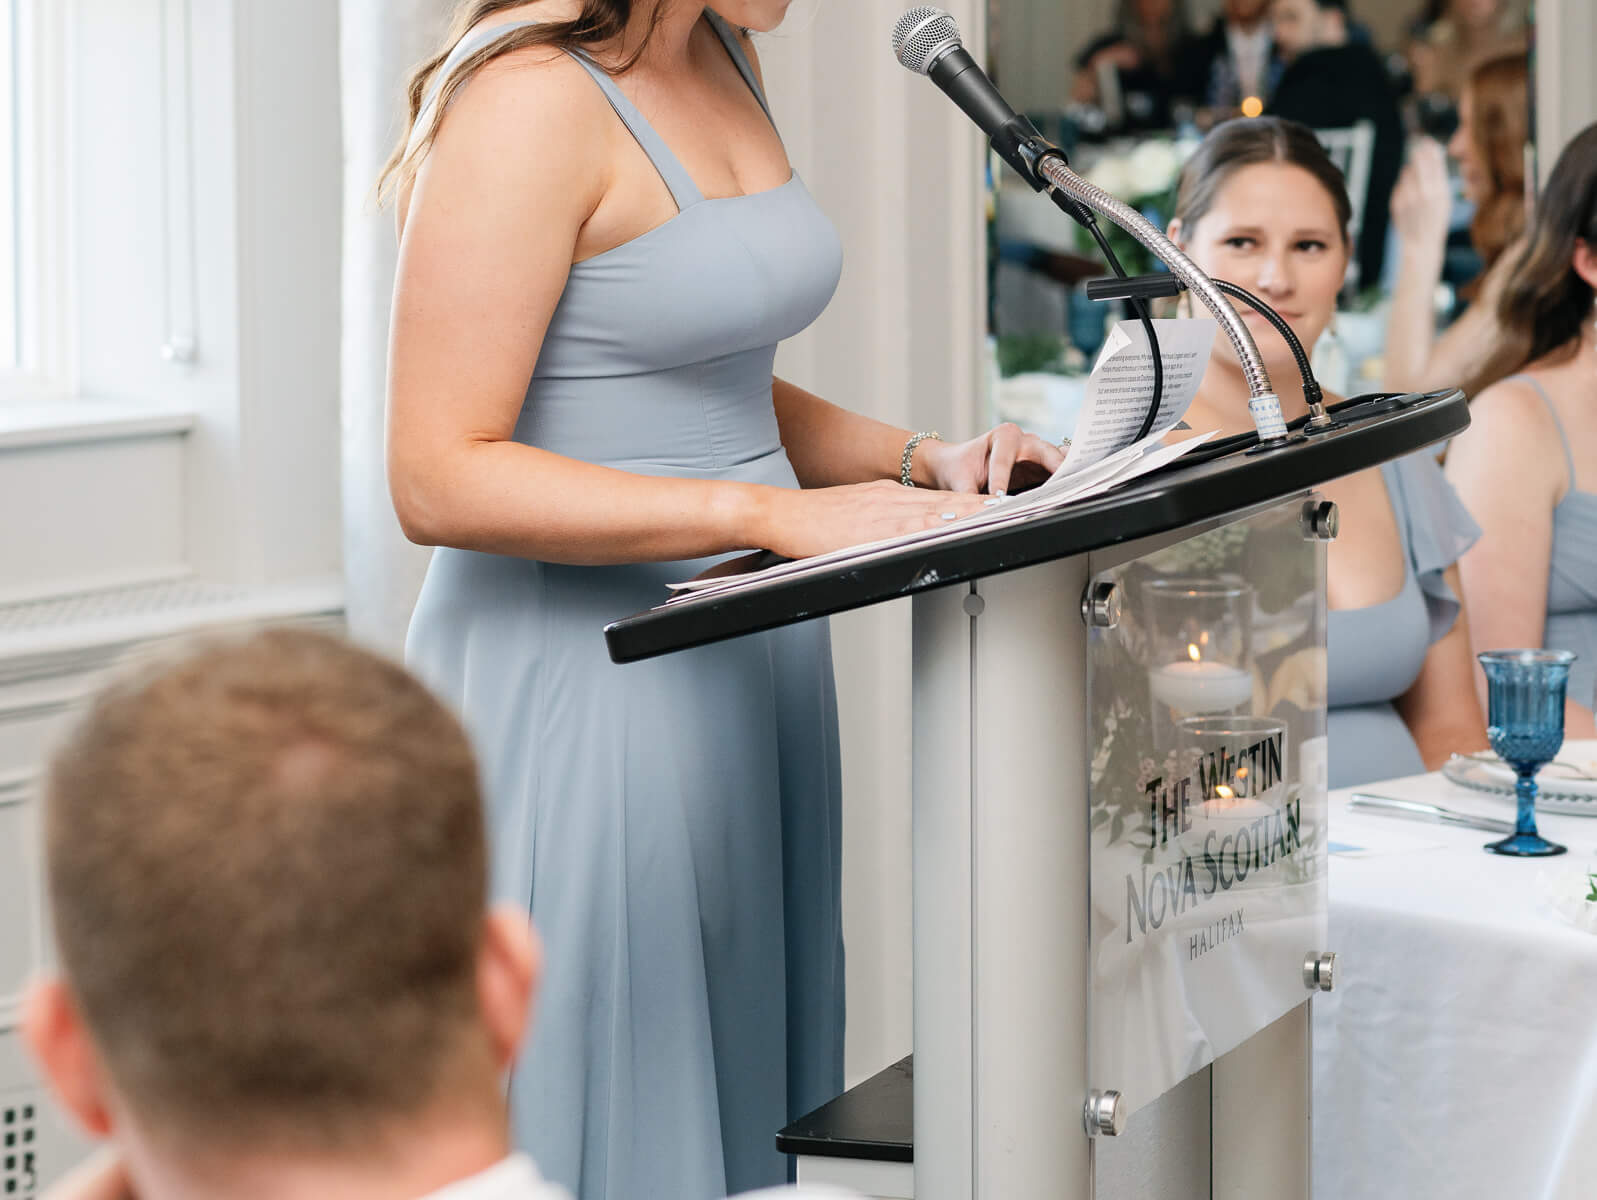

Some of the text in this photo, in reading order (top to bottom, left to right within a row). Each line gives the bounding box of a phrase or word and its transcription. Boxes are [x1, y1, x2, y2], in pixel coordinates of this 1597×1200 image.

[1145, 732, 1283, 849] THE WESTIN
[1126, 798, 1301, 943] NOVA SCOTIAN
[1190, 908, 1245, 960] HALIFAX
